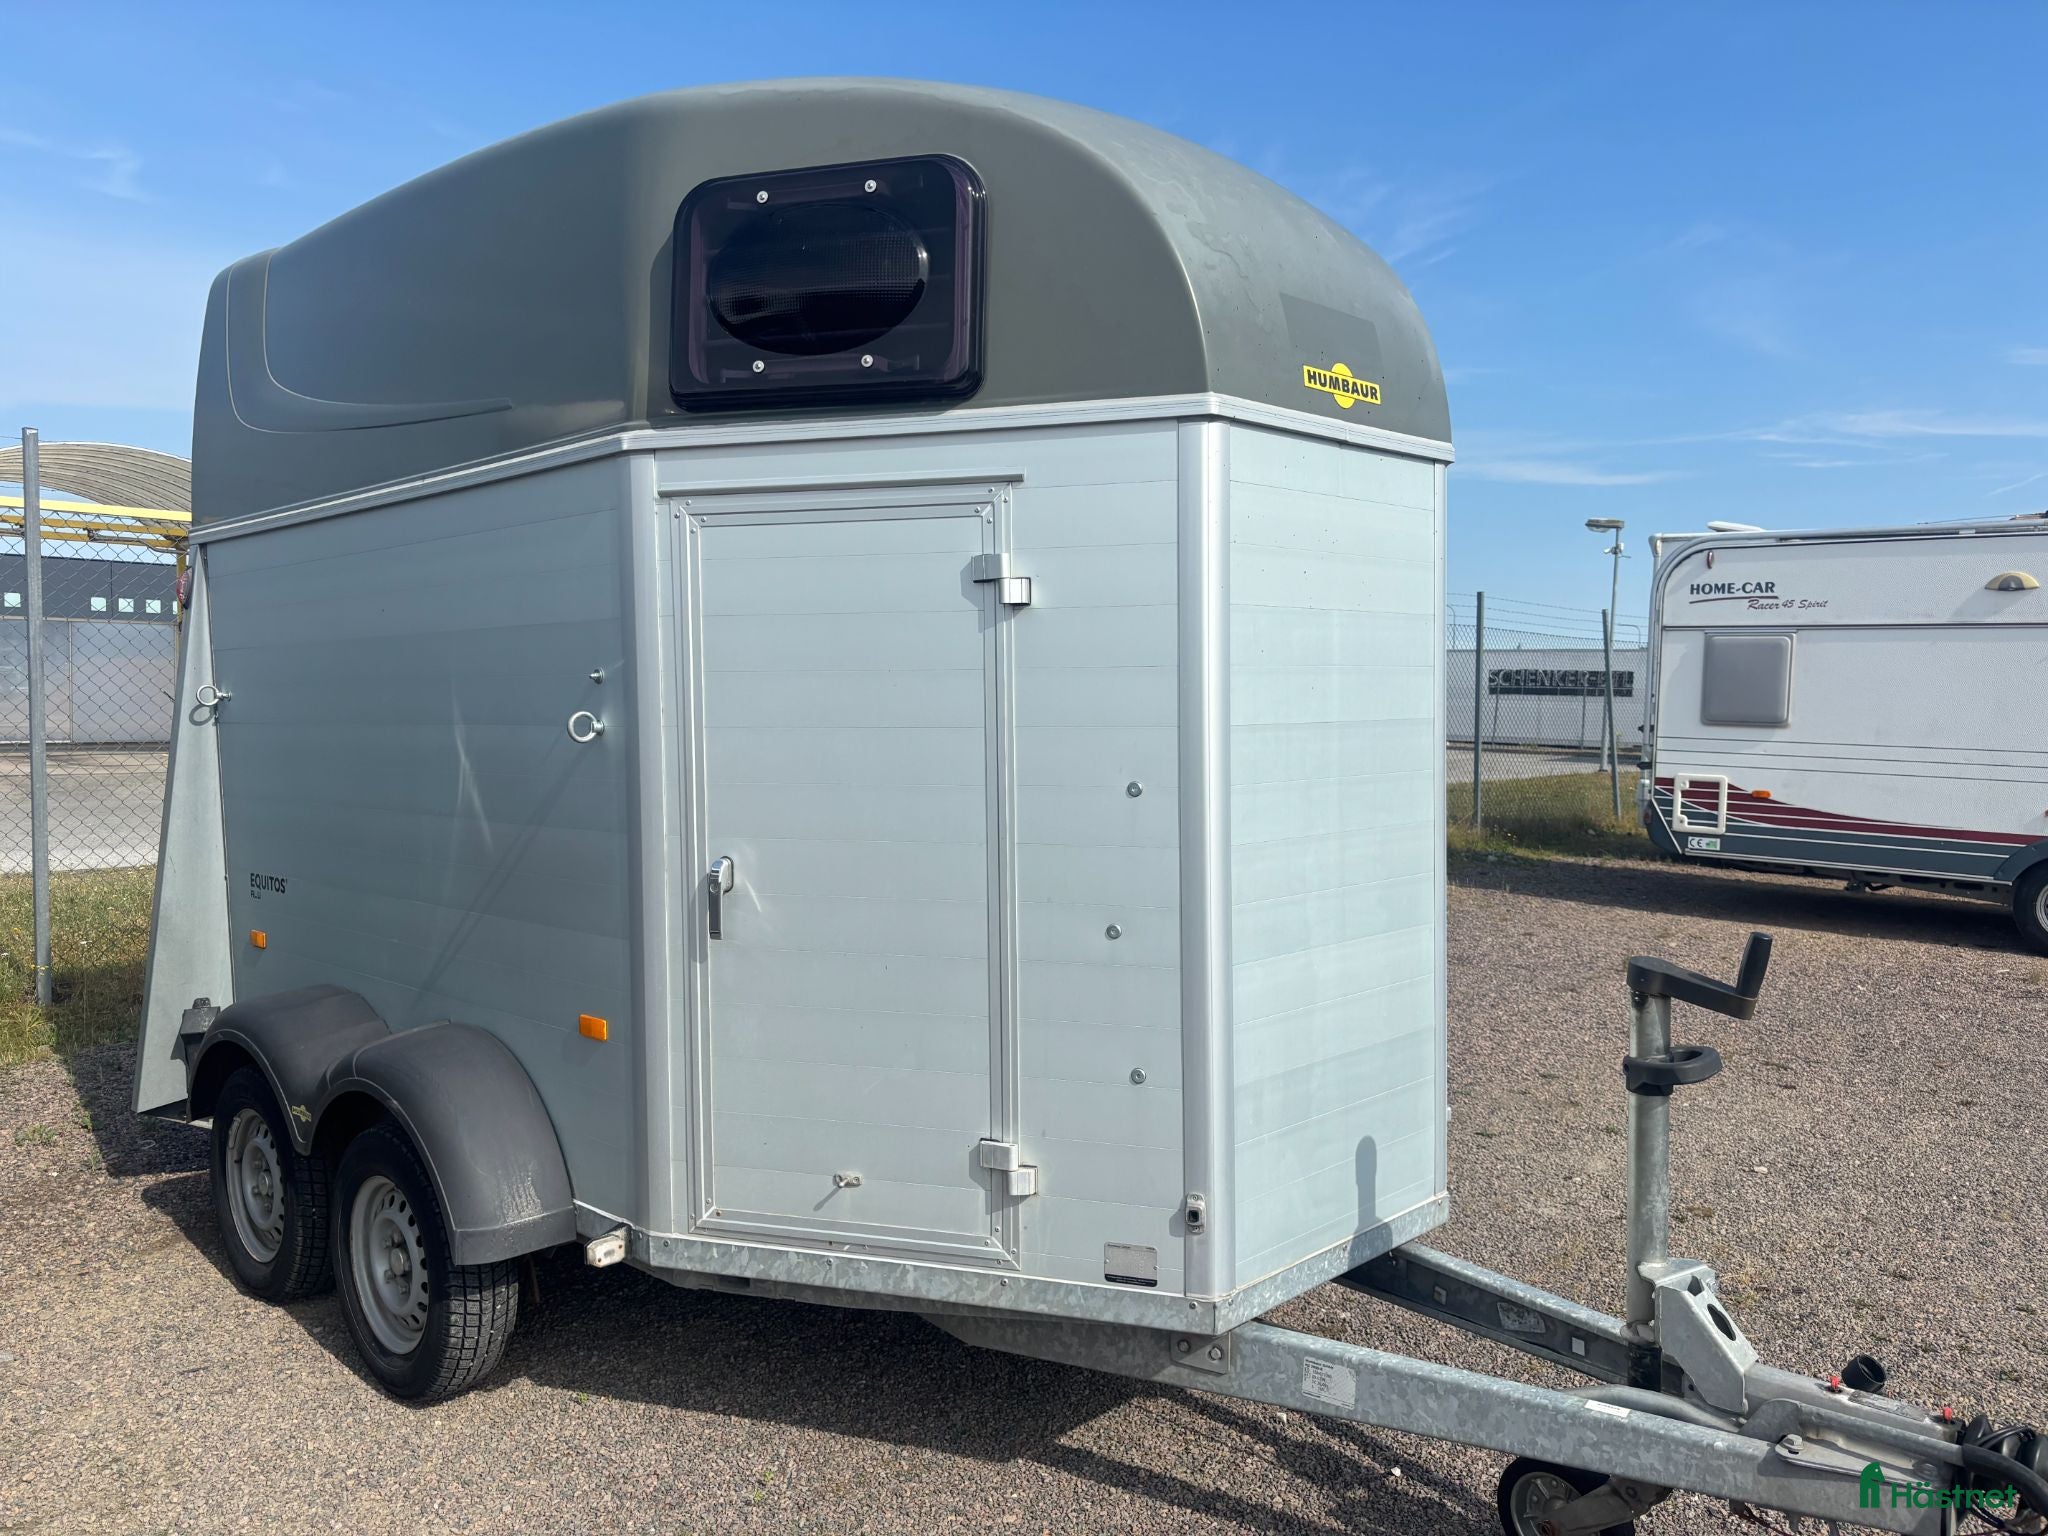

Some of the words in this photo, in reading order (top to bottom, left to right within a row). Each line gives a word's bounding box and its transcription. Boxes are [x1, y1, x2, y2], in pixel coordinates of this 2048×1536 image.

[1306, 369, 1379, 401] HUMBAUR
[1690, 581, 1776, 595] HOME-CAR
[1747, 599, 1780, 610] Racer
[1781, 600, 1796, 609] 45
[1797, 600, 1829, 610] Spirit
